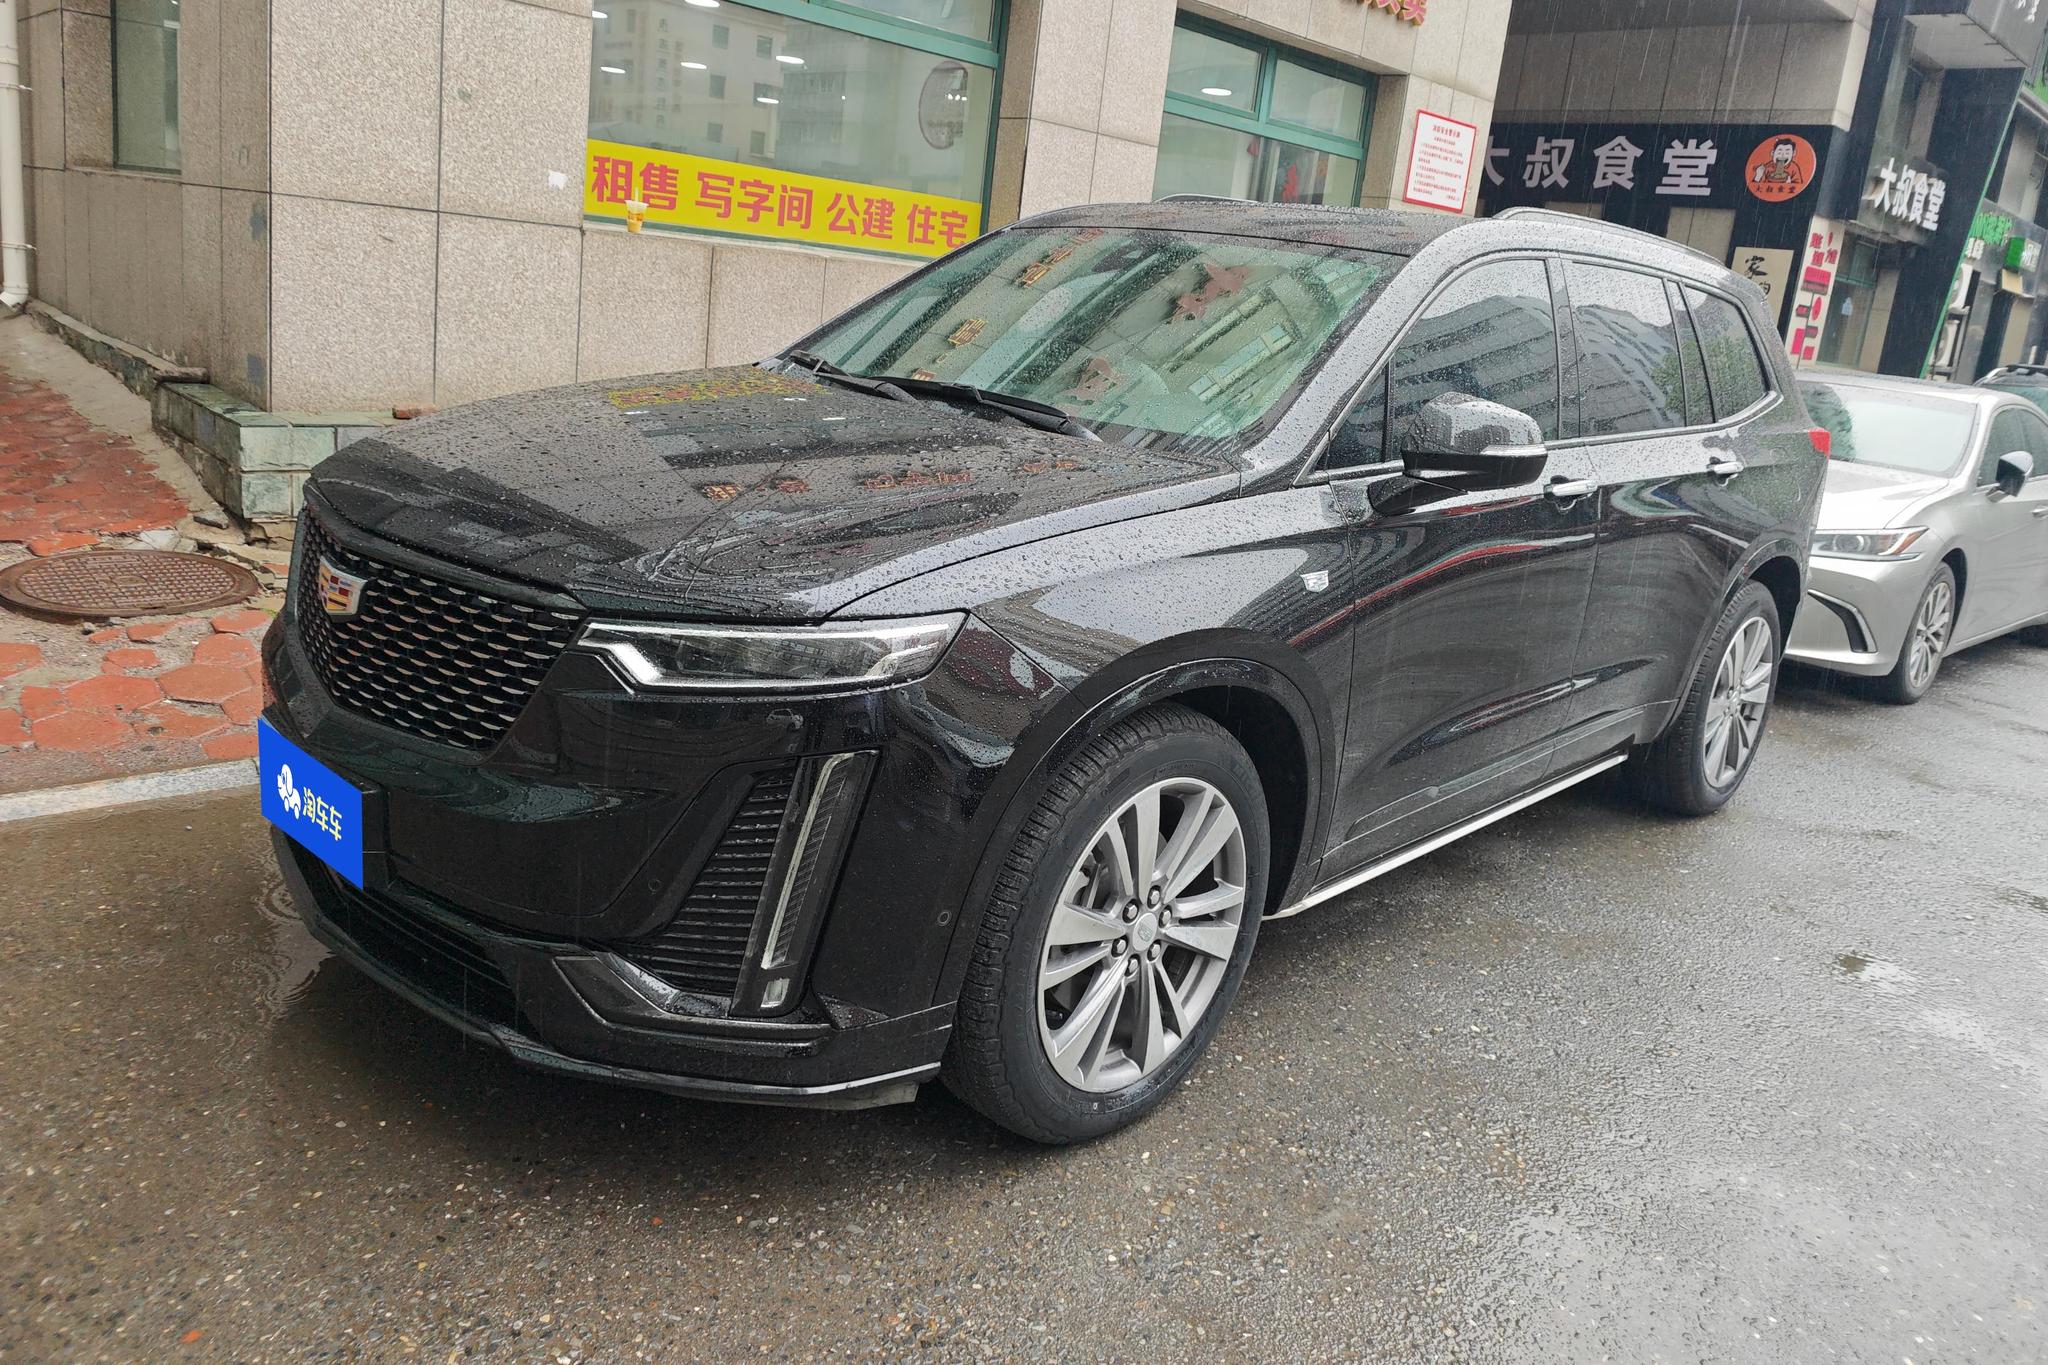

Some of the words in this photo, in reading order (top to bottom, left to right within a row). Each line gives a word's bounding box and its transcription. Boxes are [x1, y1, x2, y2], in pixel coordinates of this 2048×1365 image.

[591, 155, 679, 211] 租售
[695, 172, 814, 230] 写字间
[826, 192, 895, 239] 公建
[906, 204, 968, 248] 住宅
[1874, 157, 1946, 231] 大叔食堂
